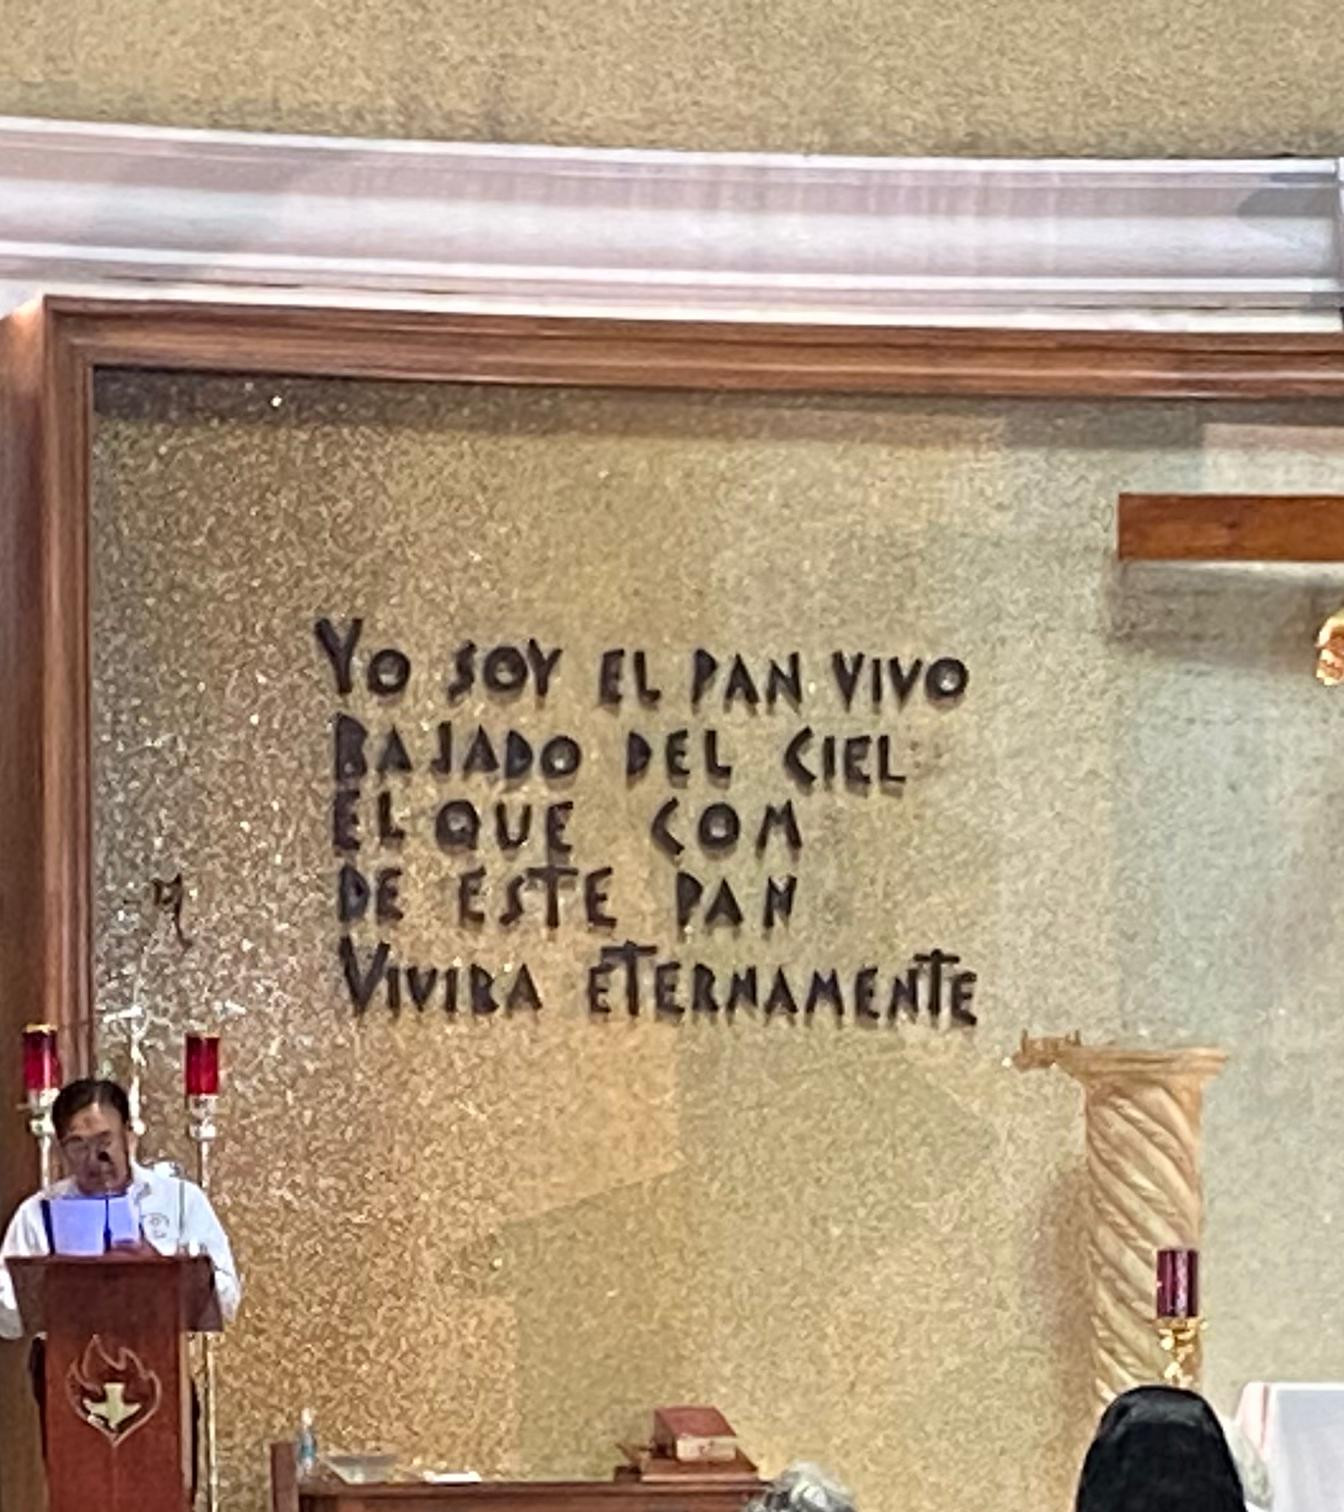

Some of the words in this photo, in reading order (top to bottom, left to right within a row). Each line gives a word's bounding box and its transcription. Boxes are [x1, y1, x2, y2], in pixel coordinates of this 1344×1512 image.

[447, 636, 562, 698] SOY
[599, 648, 661, 707] EL
[691, 647, 803, 712] PAN
[832, 650, 970, 712] VIVO
[626, 727, 733, 782] DEL
[332, 789, 407, 853] EL
[434, 799, 576, 855] QUE
[338, 864, 404, 925] DE
[457, 865, 618, 930] ESTE
[674, 873, 798, 932] PAN
[585, 939, 979, 1028] ETERNAMENTE
